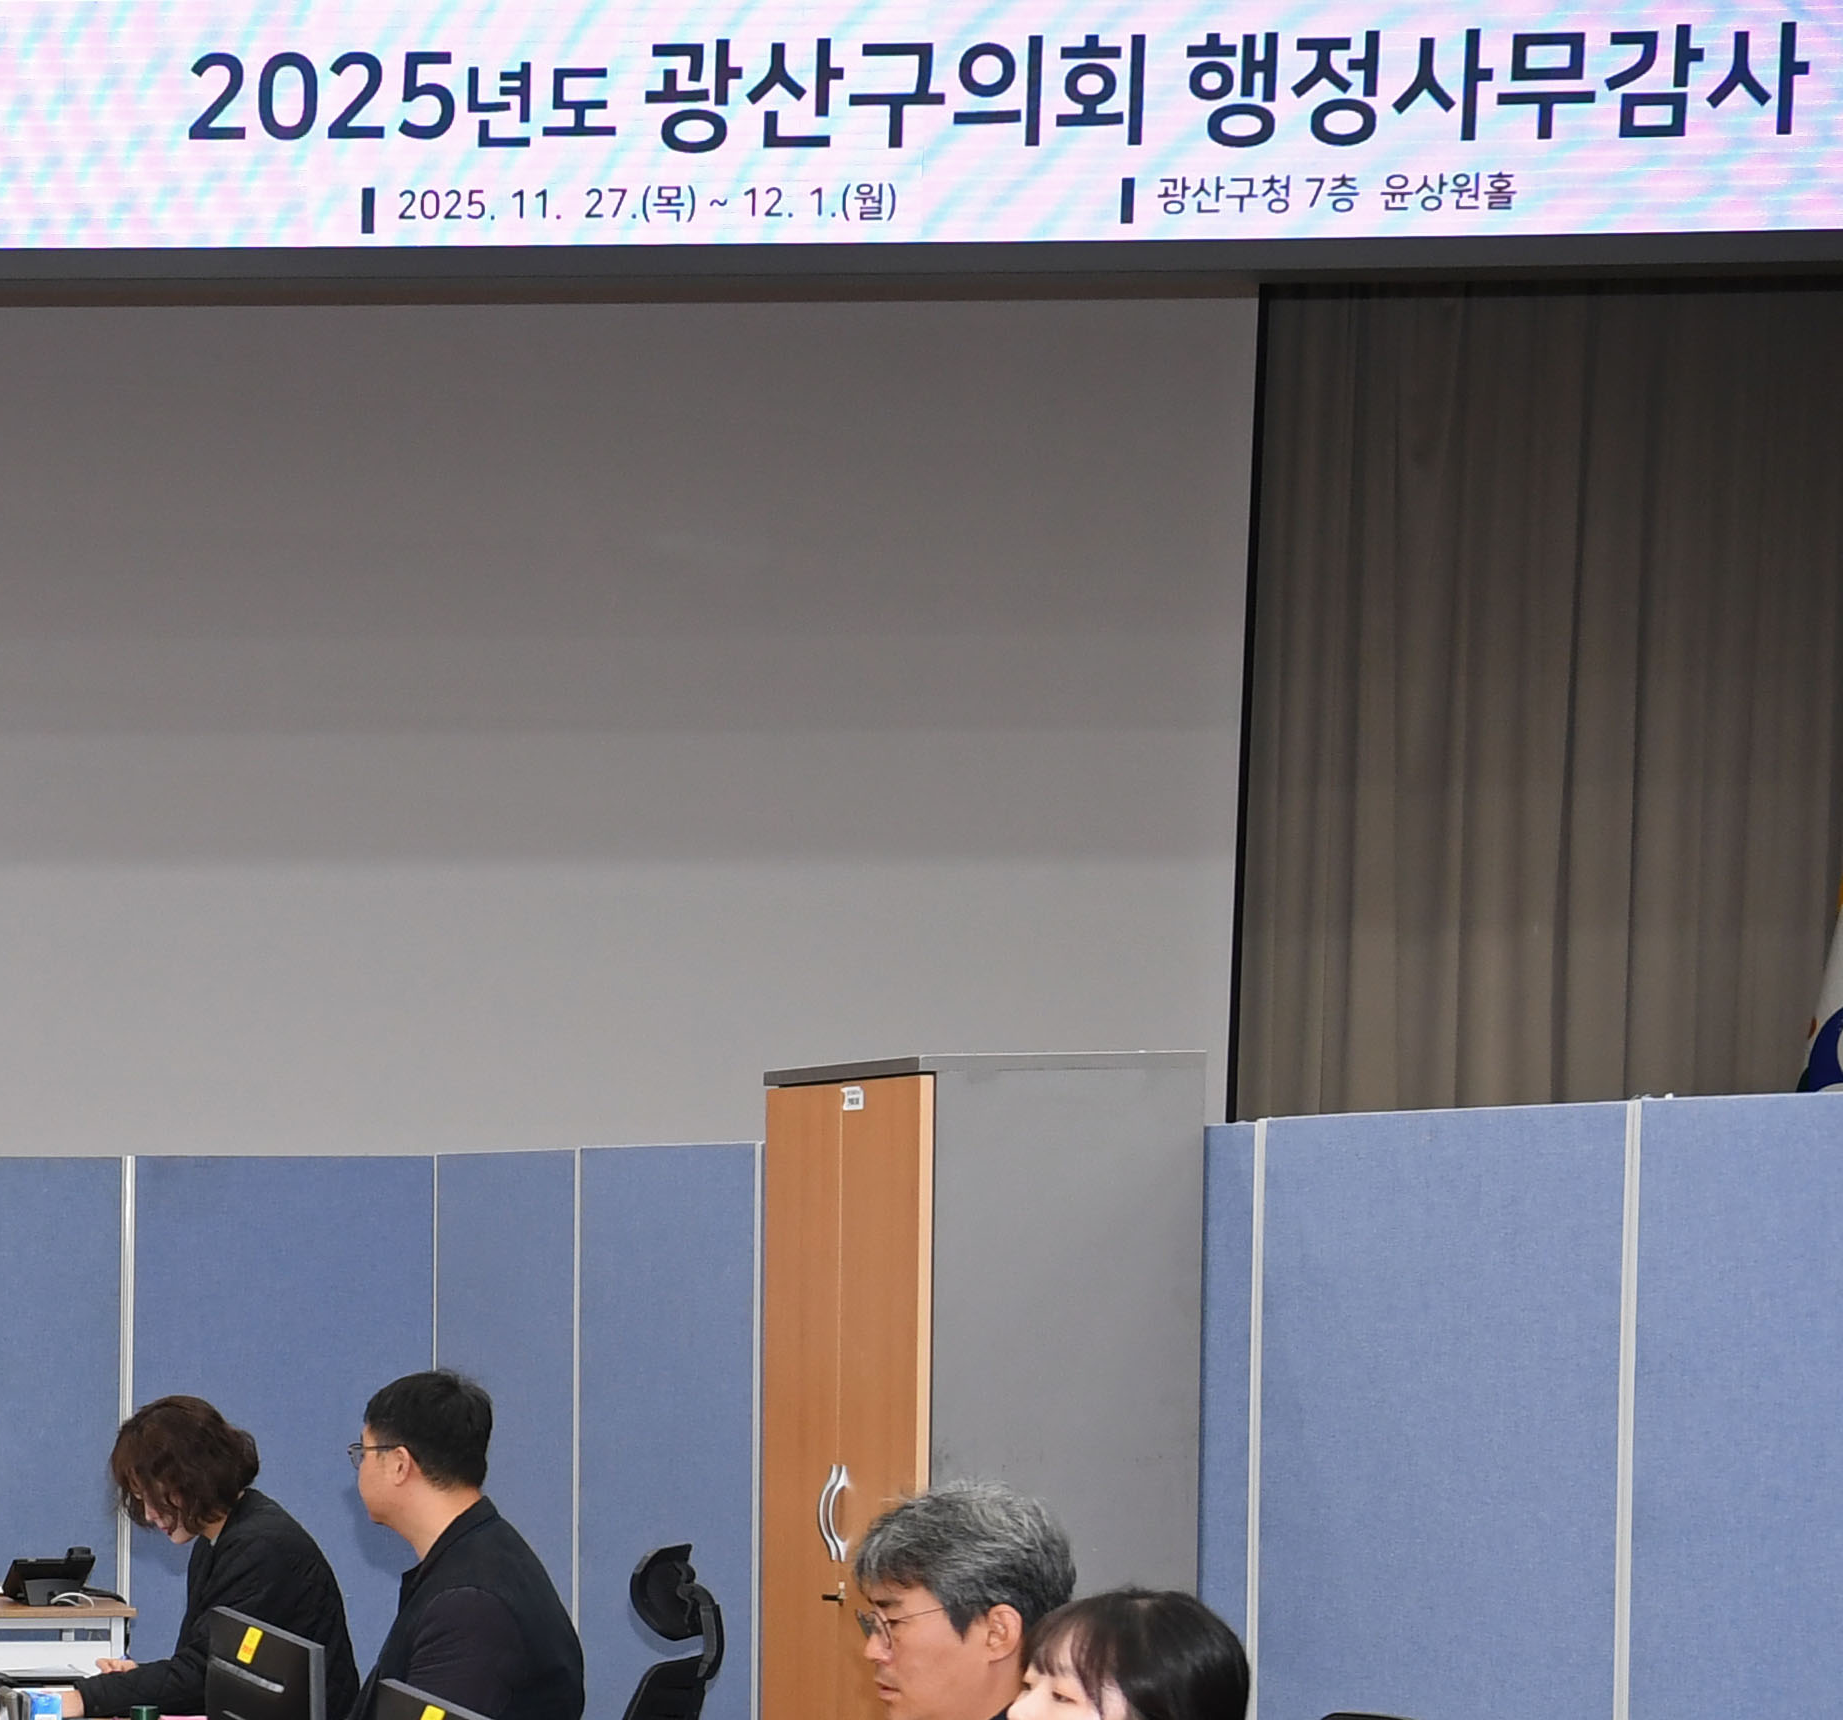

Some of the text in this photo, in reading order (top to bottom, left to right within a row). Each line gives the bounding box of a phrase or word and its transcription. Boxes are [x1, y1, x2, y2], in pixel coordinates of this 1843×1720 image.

[187, 22, 1810, 152] 2025년도 광산구의회 행정사무감사
[397, 188, 496, 221] 2025.
[512, 188, 563, 220] 11.
[584, 184, 697, 222] 27.(목)
[742, 186, 794, 219] 12.
[810, 181, 898, 222] 1.(월)
[1157, 171, 1518, 214] 광산구청 7층 윤상원홀
